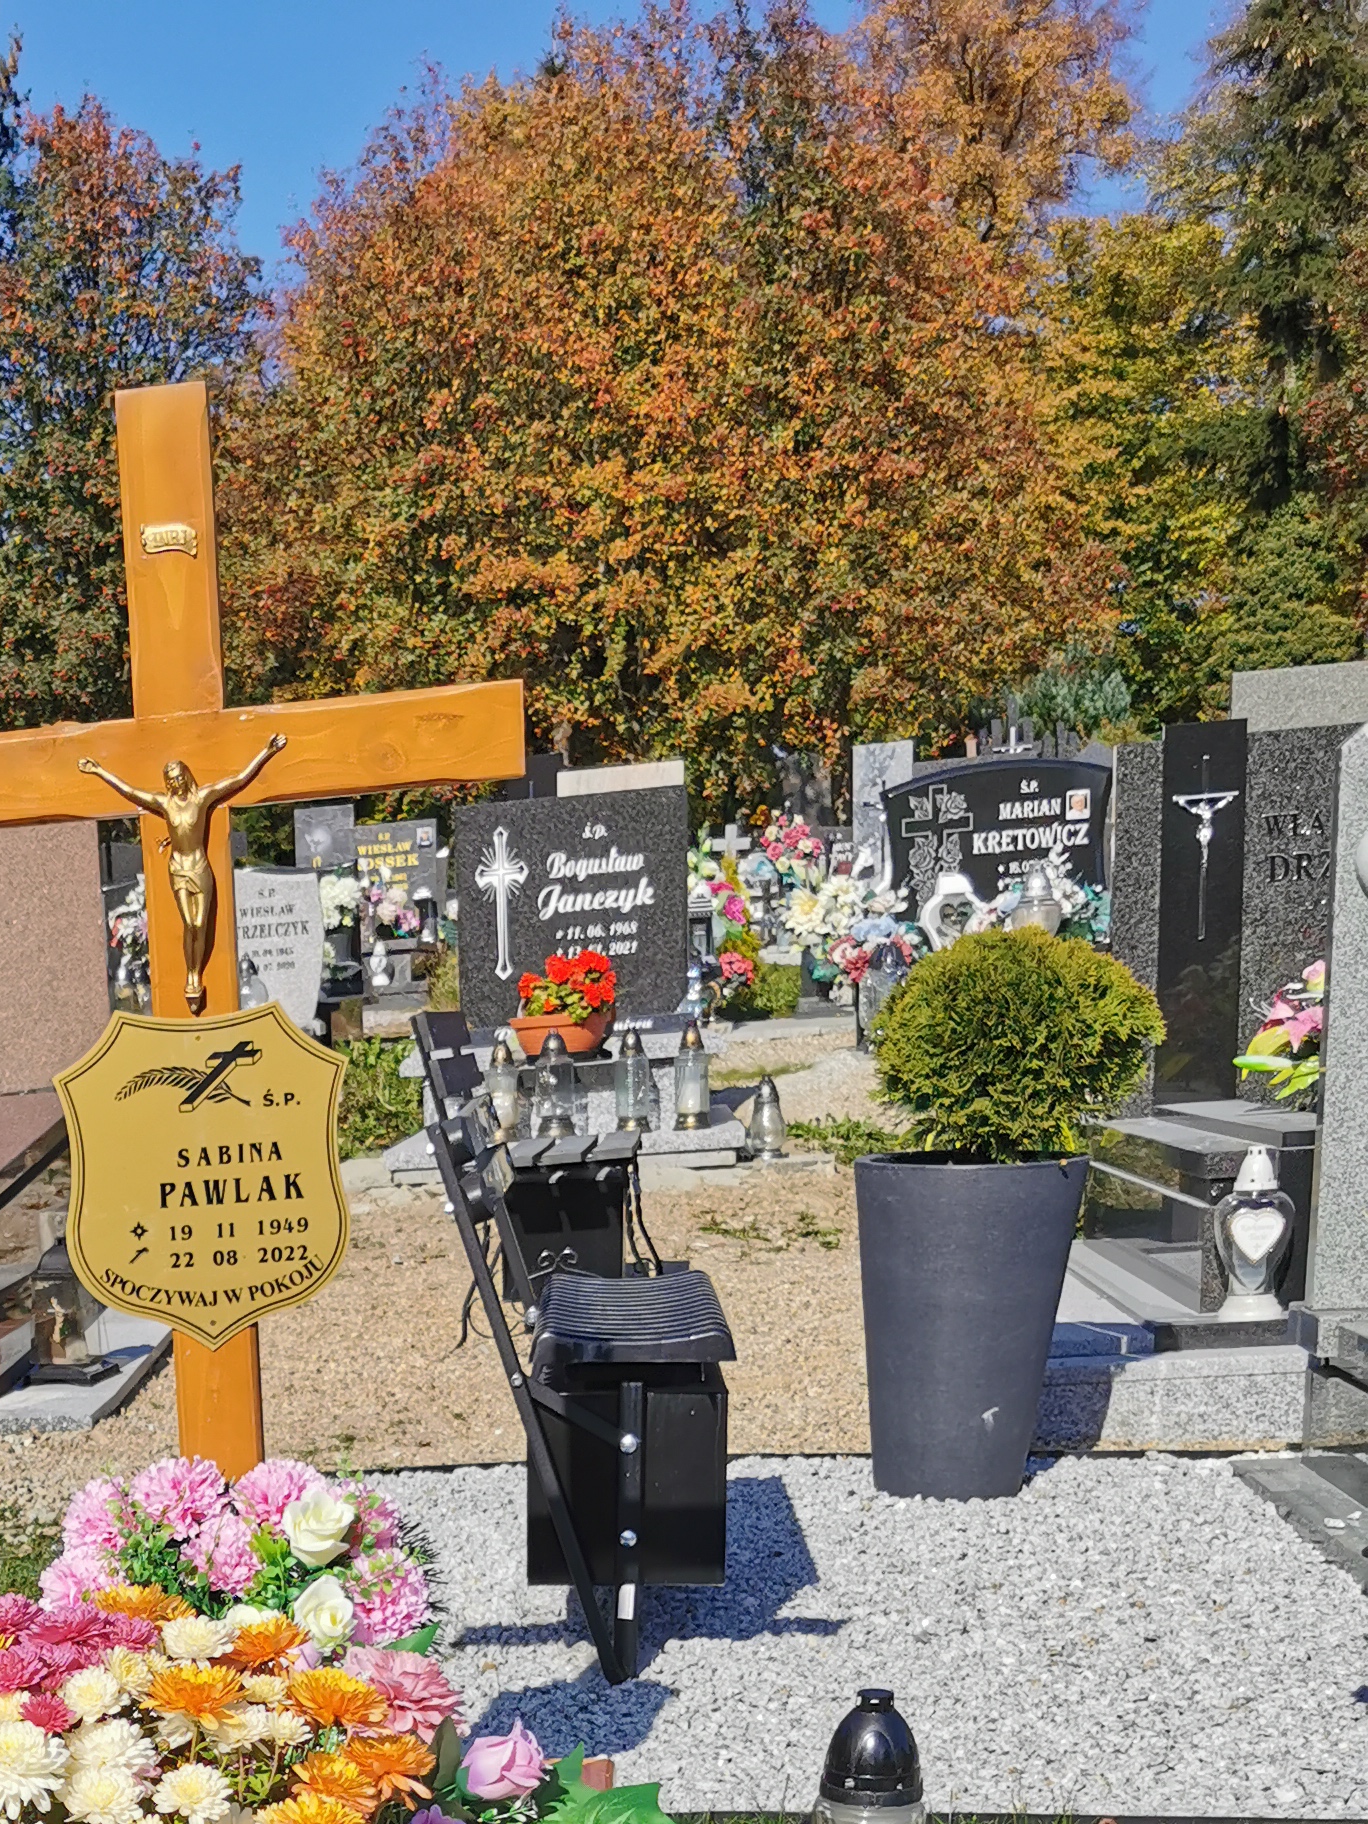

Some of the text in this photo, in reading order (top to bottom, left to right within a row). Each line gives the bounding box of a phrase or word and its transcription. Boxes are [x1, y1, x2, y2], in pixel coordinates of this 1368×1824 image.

[998, 798, 1062, 820] MARIAN
[972, 822, 1090, 855] KRETOWICZ
[357, 853, 419, 872] OSSEK
[546, 846, 645, 882] Bogusław
[537, 877, 655, 920] Janczyk
[237, 920, 310, 940] RZELCZYK
[177, 1141, 283, 1168] SABINA
[160, 1172, 305, 1209] PAWLAK
[170, 1217, 309, 1241] 19 11 1949
[170, 1245, 309, 1269] 22 08 2022
[100, 1254, 326, 1308] SPOCZYWAJ W POKOJU
